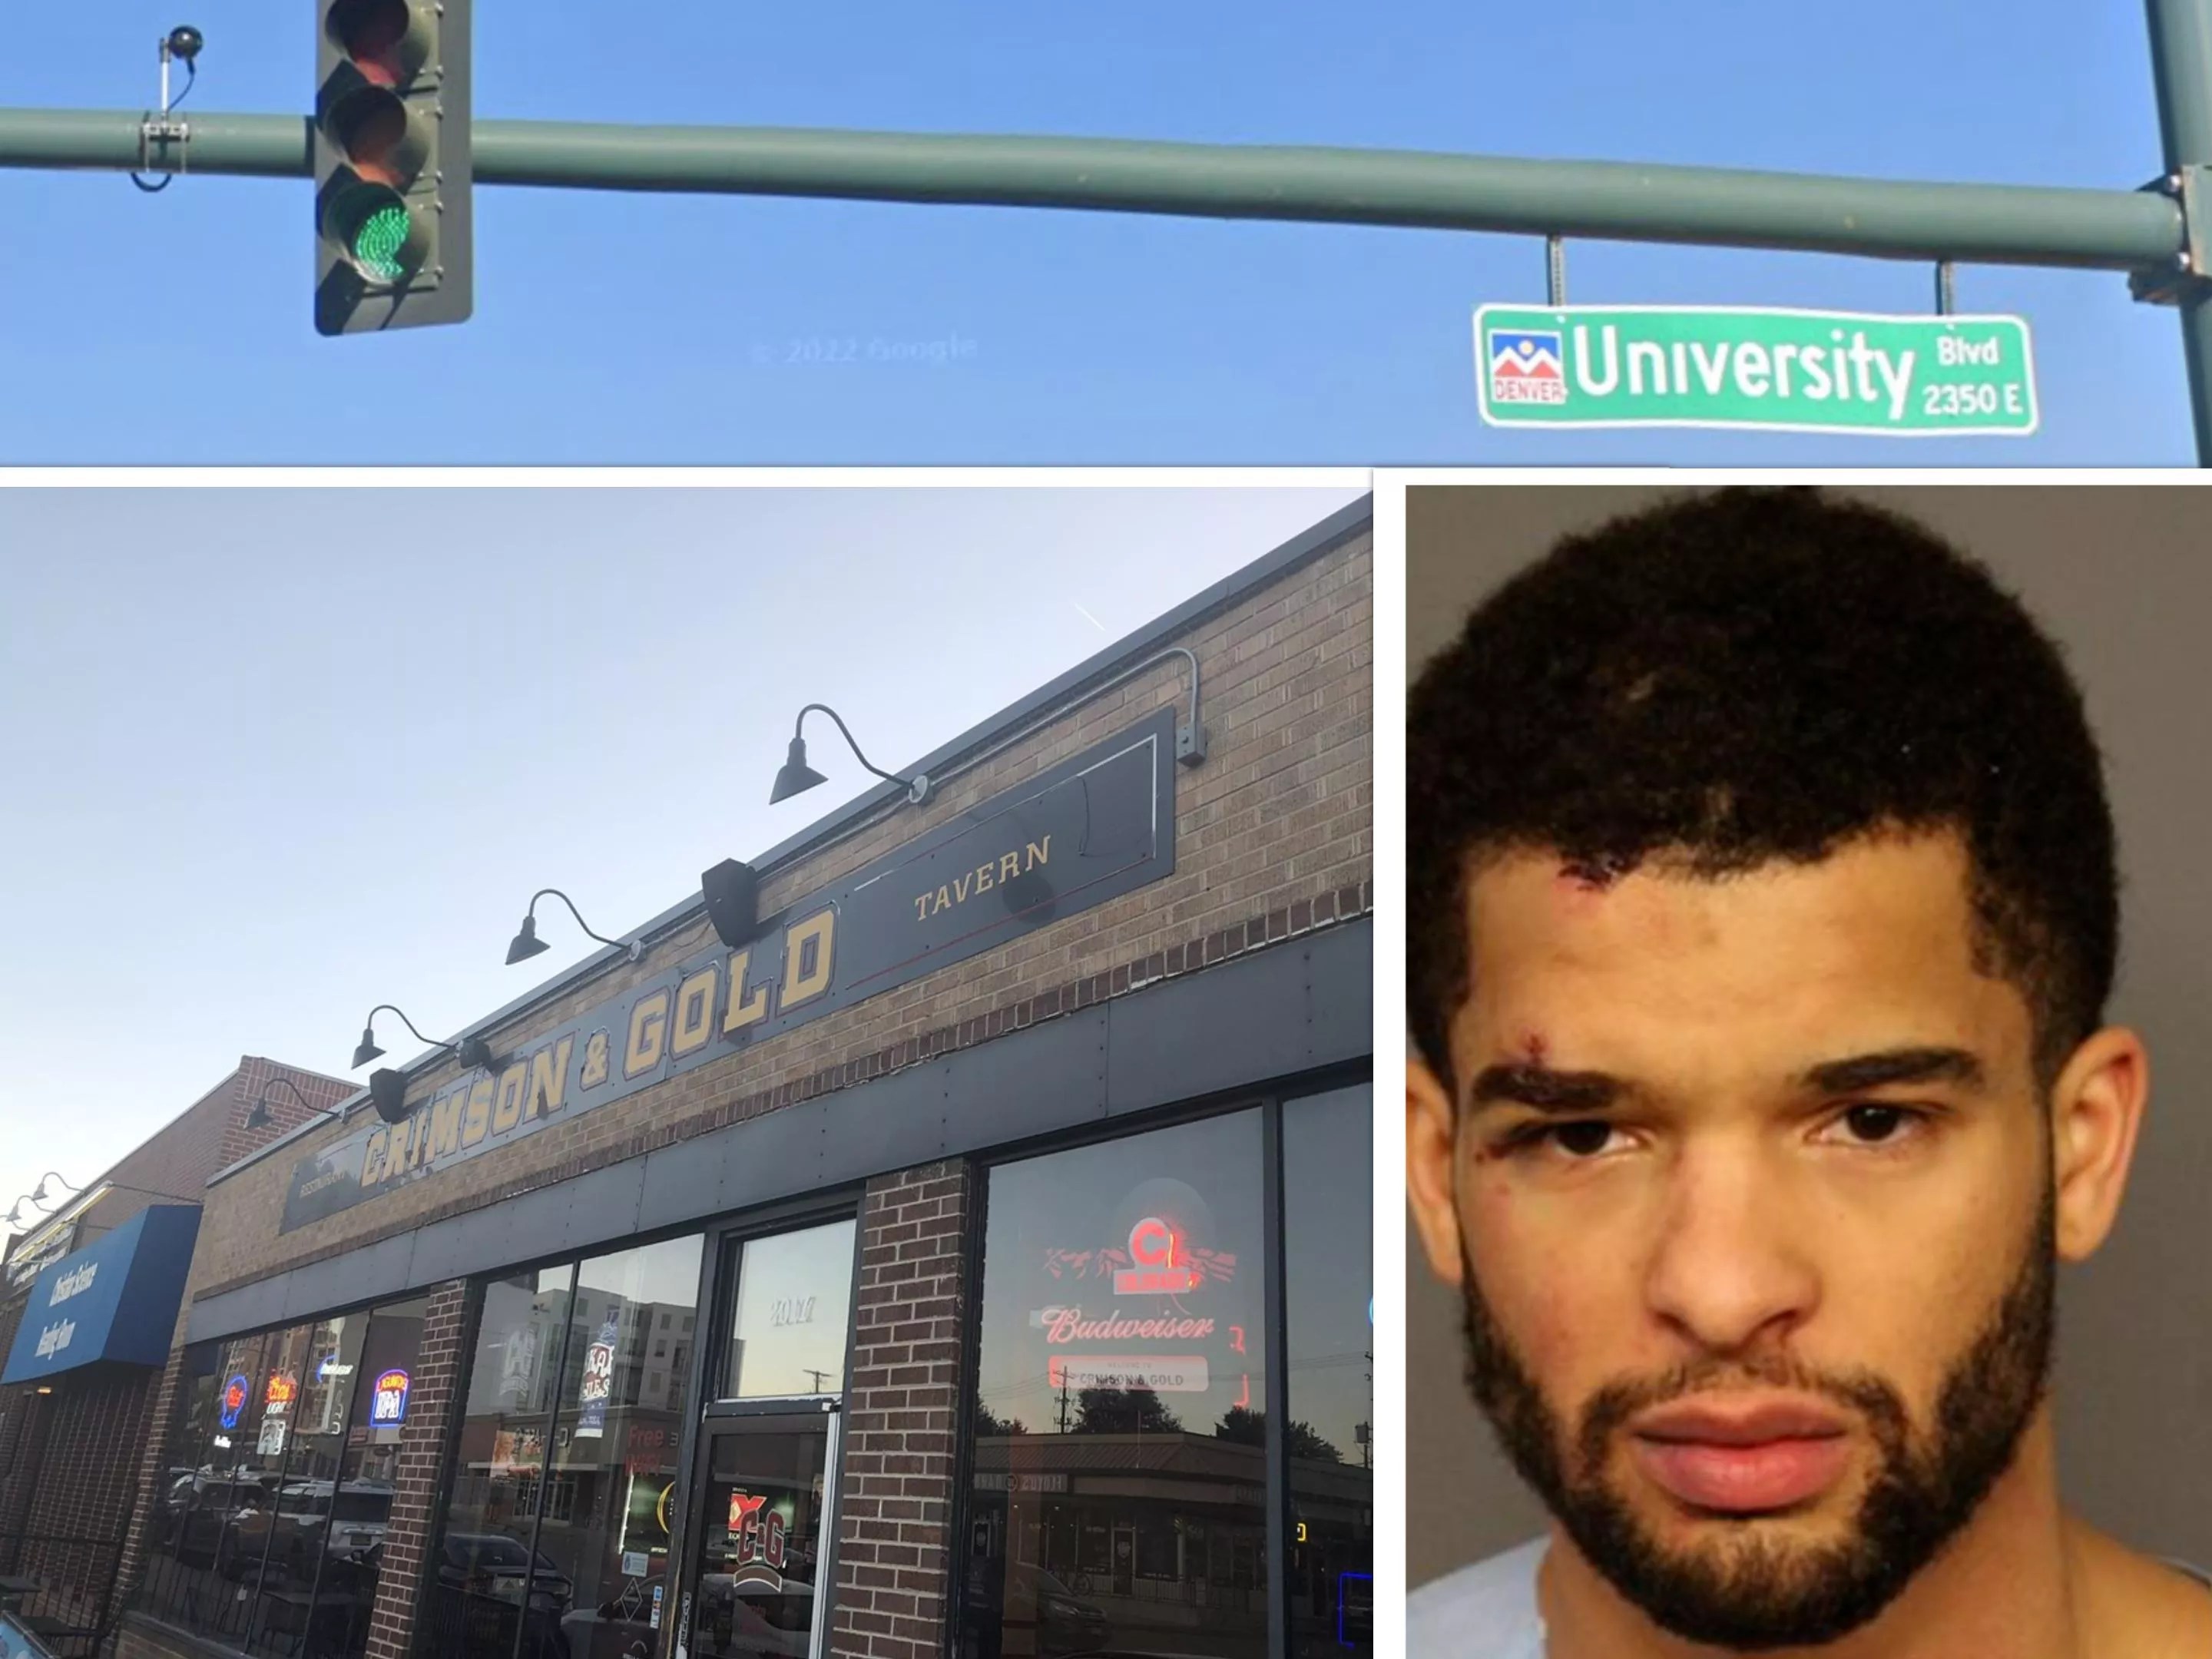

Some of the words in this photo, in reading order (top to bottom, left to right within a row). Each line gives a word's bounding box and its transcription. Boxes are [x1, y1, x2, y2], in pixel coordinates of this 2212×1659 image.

[1574, 324, 1914, 419] University
[1936, 336, 1998, 366] Blvd
[1495, 379, 1564, 400] DENVER
[1922, 383, 1997, 416] 2350
[2003, 383, 2024, 415] E
[914, 835, 1051, 922] TAVERN
[360, 1033, 575, 1187] CRIMSON
[580, 1026, 611, 1092] &
[623, 900, 839, 1081] GOLD
[1041, 1307, 1214, 1343] Budweiser
[1150, 1375, 1184, 1386] GOLD
[628, 1425, 664, 1447] Free
